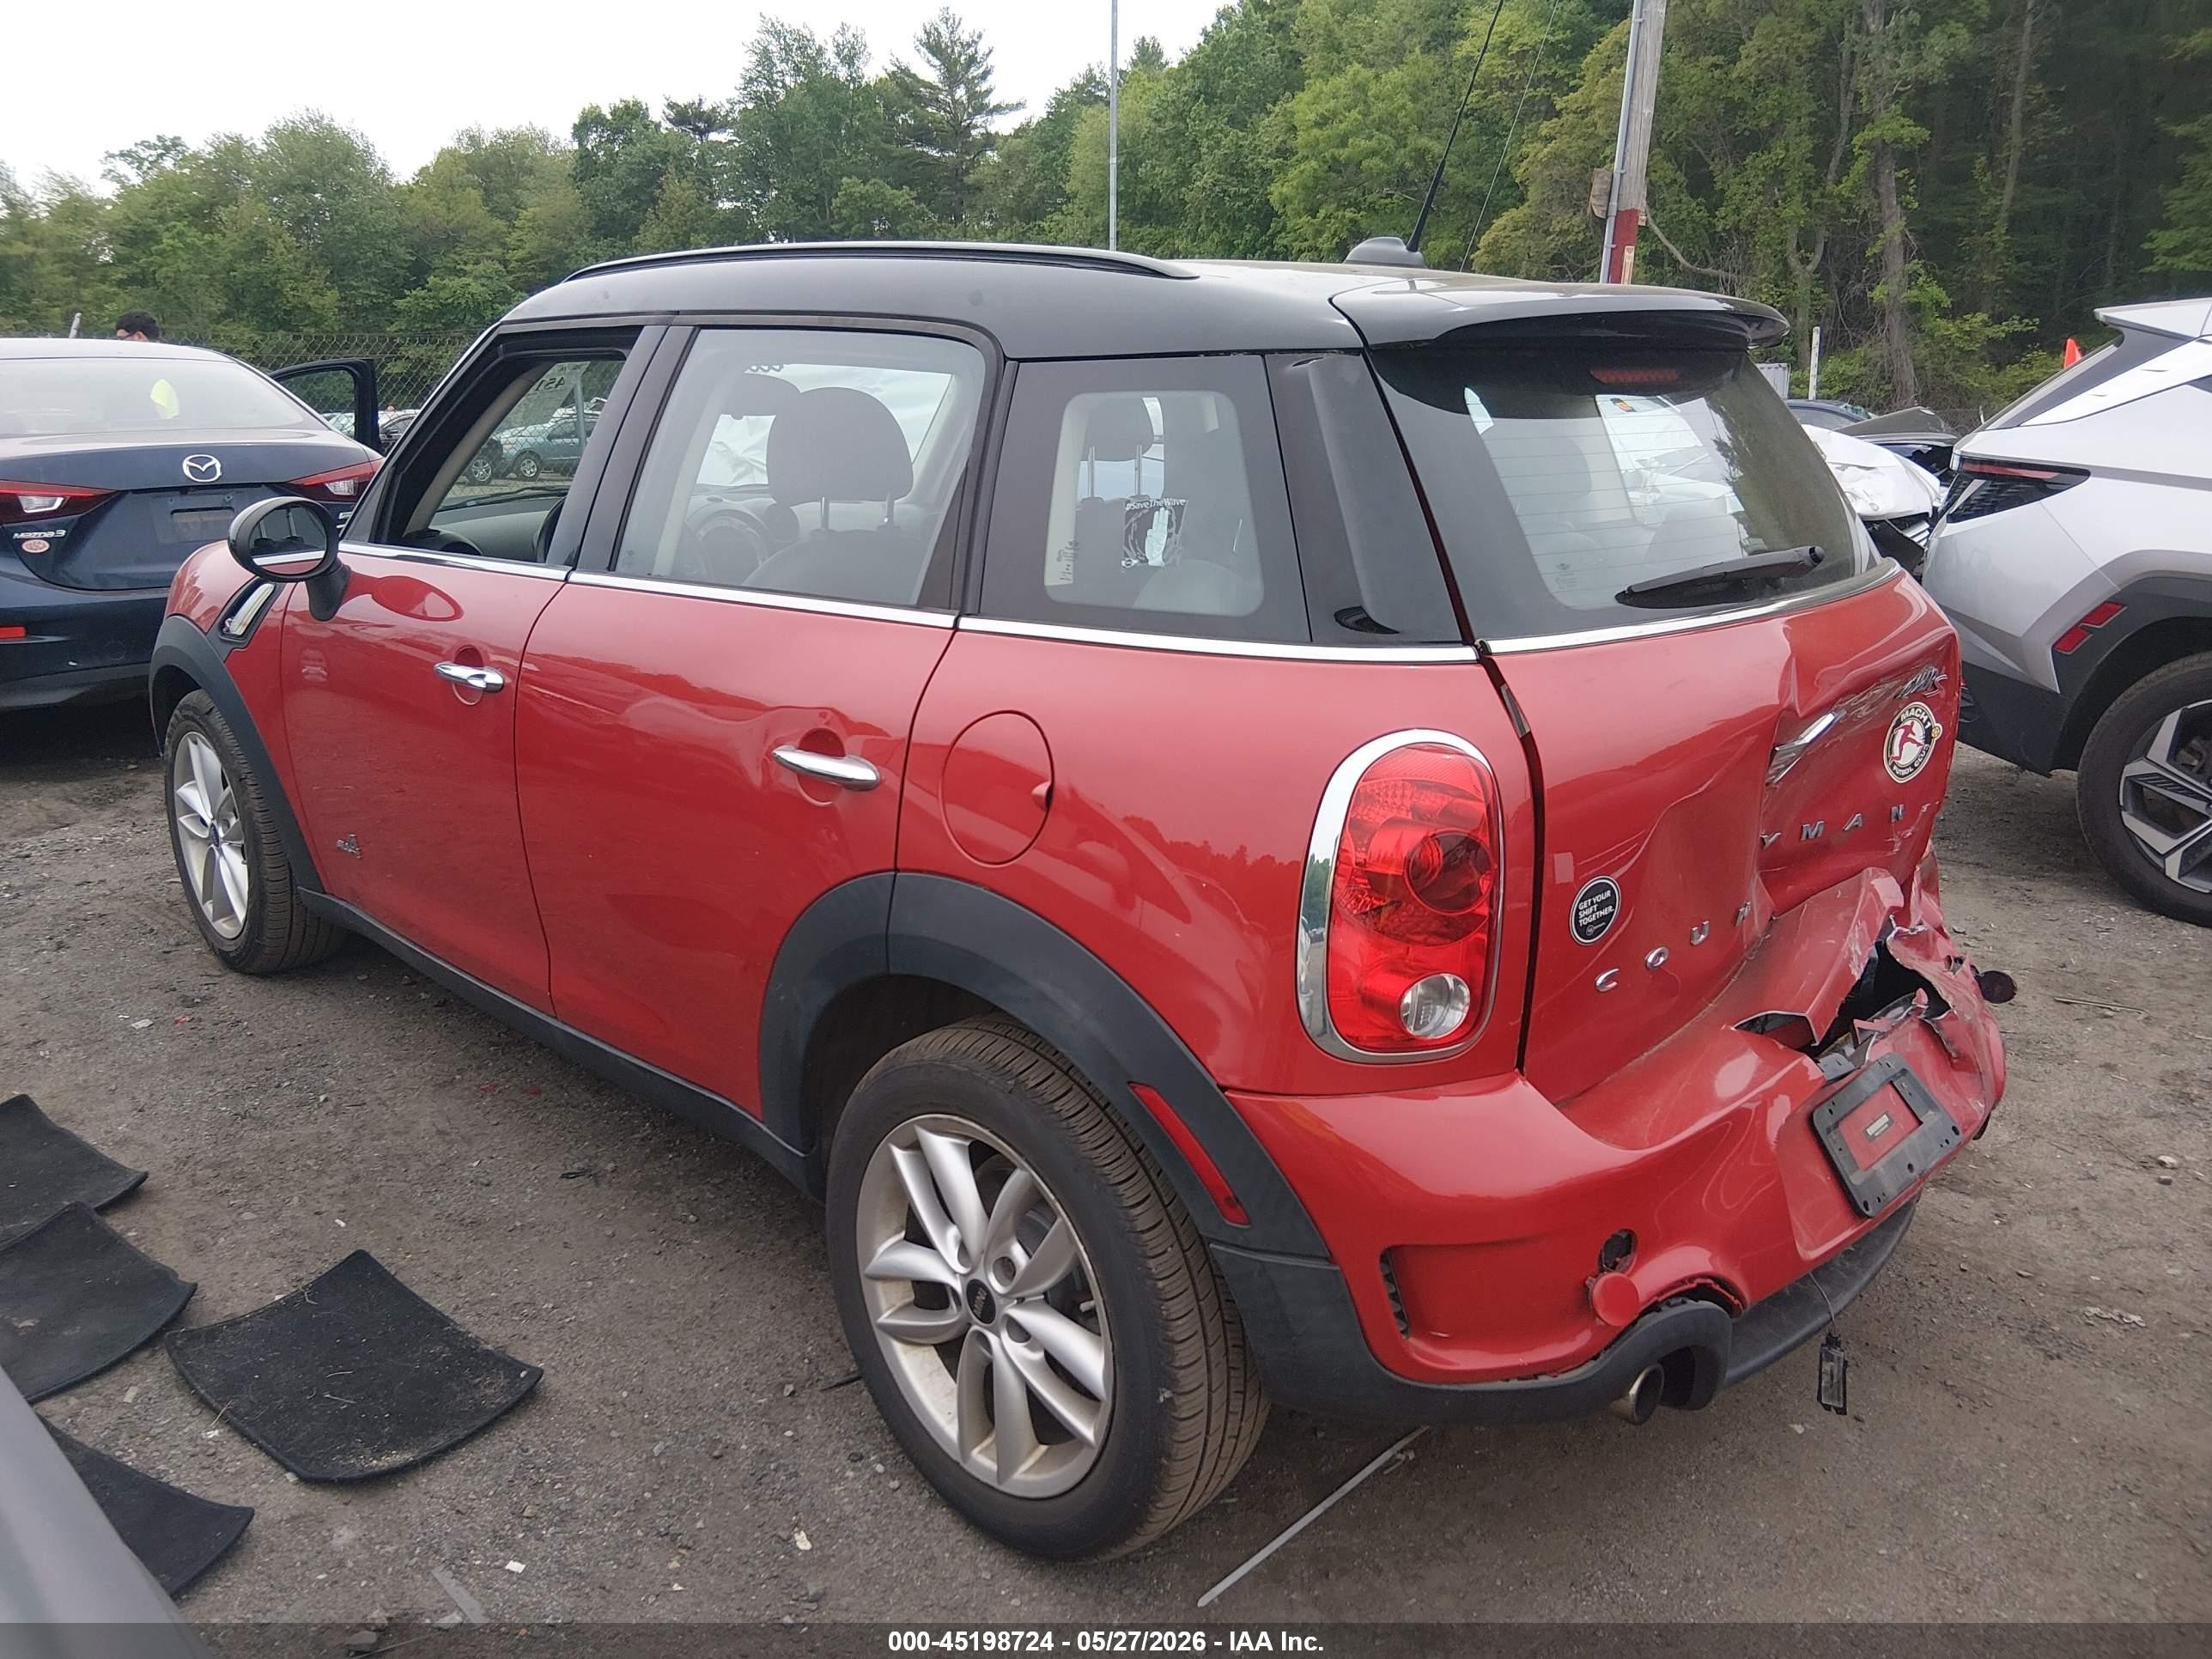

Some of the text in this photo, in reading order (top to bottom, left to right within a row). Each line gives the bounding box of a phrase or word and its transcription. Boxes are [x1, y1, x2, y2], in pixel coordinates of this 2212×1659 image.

[1900, 708, 1932, 729] MACH 1
[1578, 890, 1611, 910] GET YOUR
[1578, 904, 1599, 919] SHIFT
[1578, 905, 1615, 927] TOGETHER.
